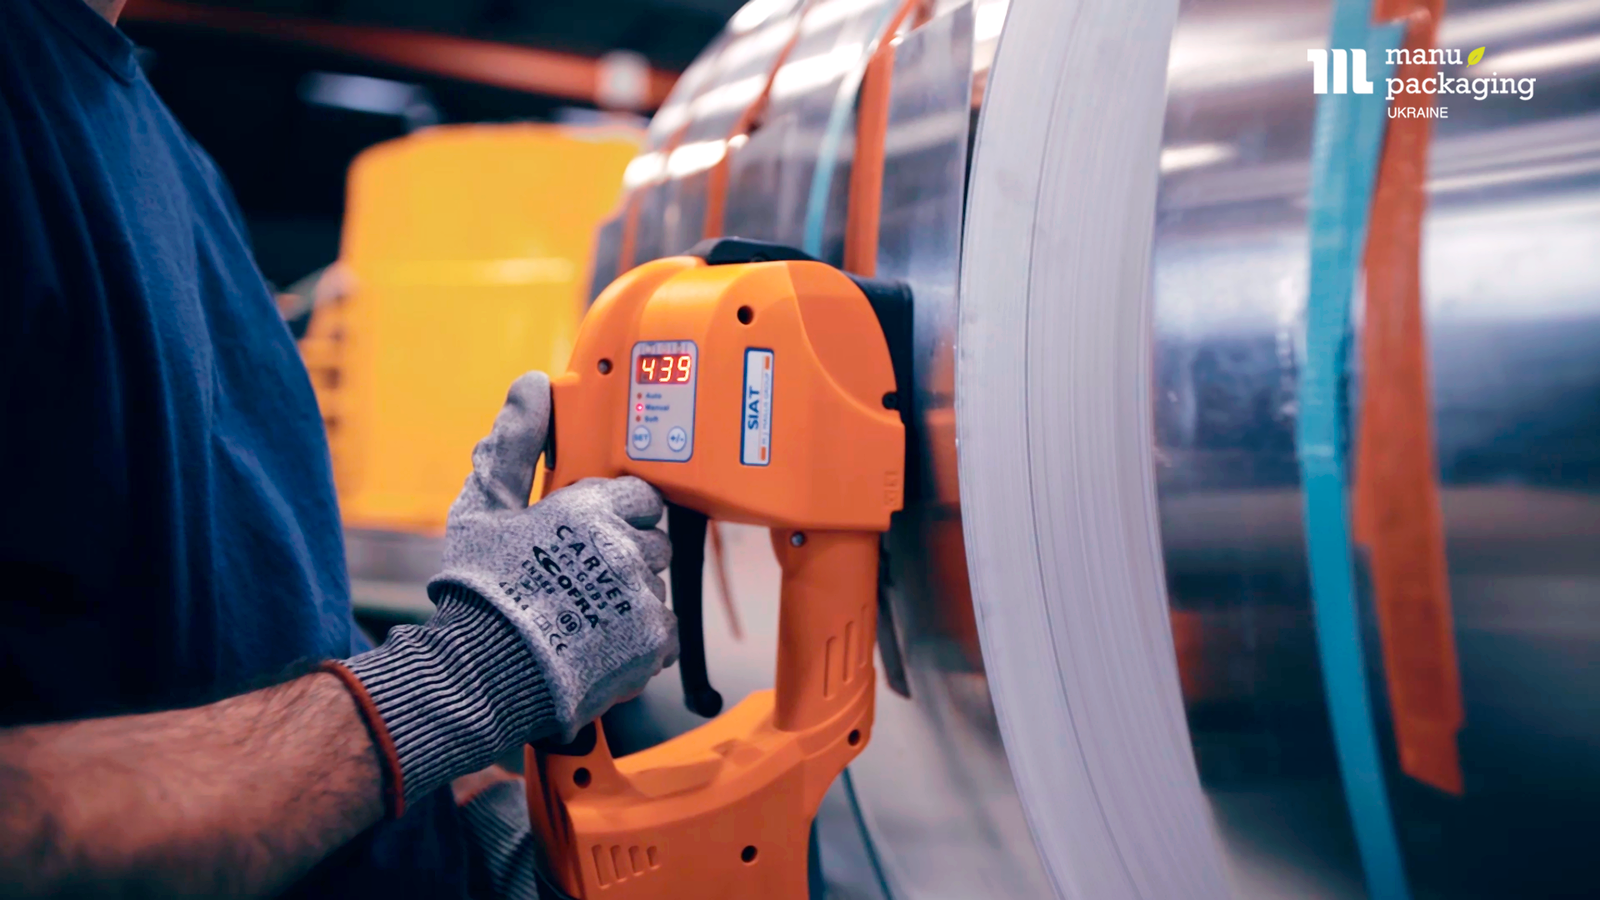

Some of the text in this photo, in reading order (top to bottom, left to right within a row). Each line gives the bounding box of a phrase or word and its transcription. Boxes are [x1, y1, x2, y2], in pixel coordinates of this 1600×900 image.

[642, 356, 691, 382] 439
[748, 386, 760, 430] SIAT
[634, 434, 649, 442] SET
[533, 546, 599, 629] COFRA
[556, 525, 631, 615] CARVER
